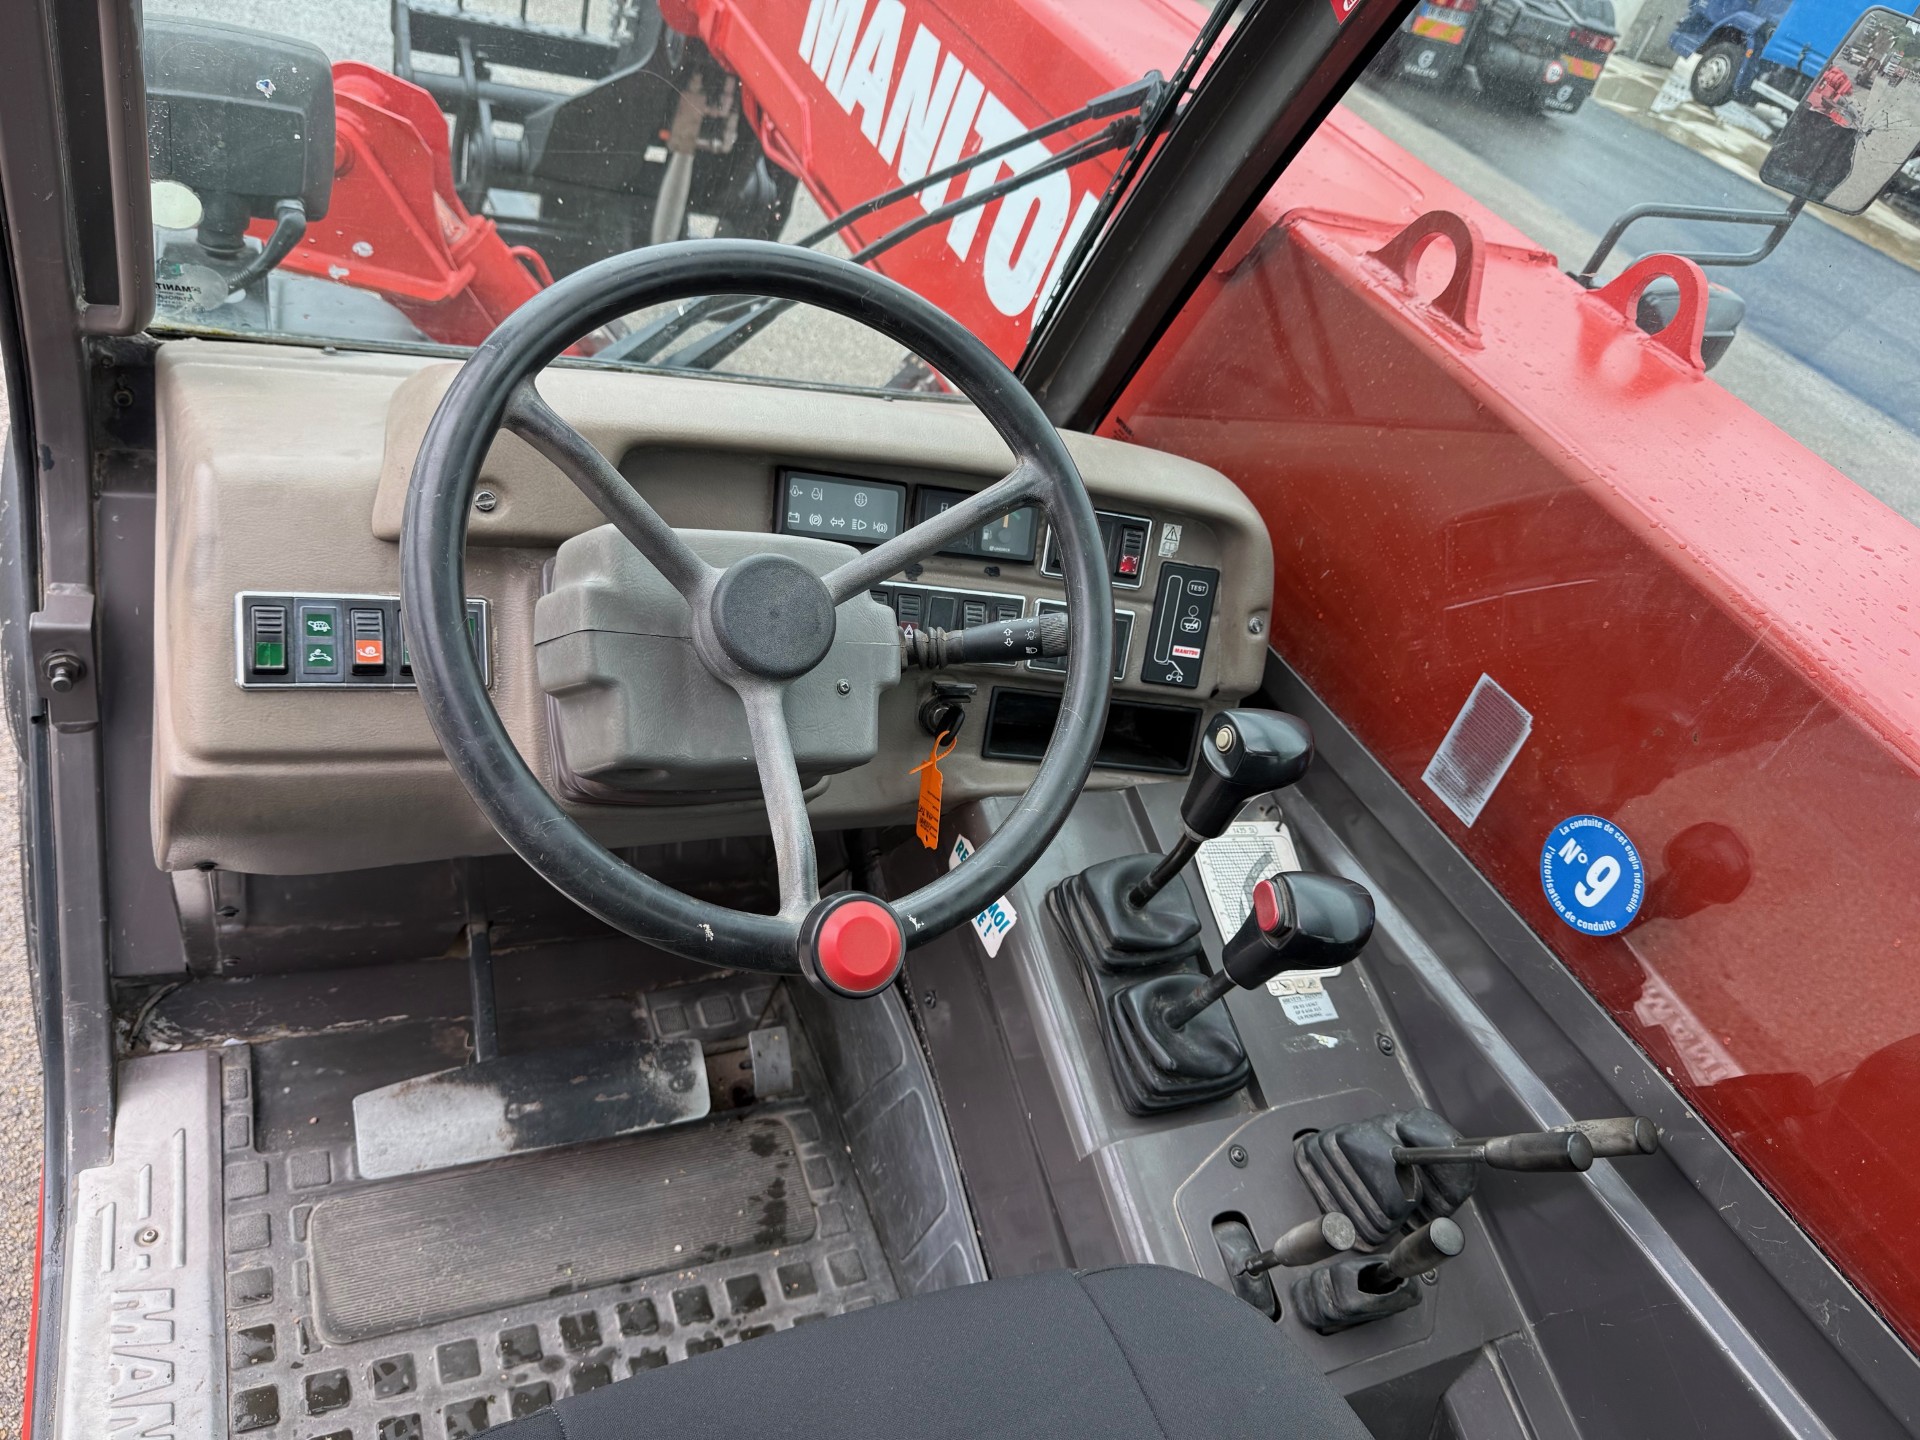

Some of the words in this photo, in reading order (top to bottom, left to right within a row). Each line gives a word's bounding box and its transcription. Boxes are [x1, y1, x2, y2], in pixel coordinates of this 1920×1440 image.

[1190, 584, 1206, 592] TEST
[1569, 817, 1603, 830] conduite
[1603, 822, 1615, 835] de
[1614, 831, 1628, 846] cet
[1624, 844, 1640, 870] engin
[1564, 911, 1576, 923] de
[1576, 919, 1617, 931] conduite
